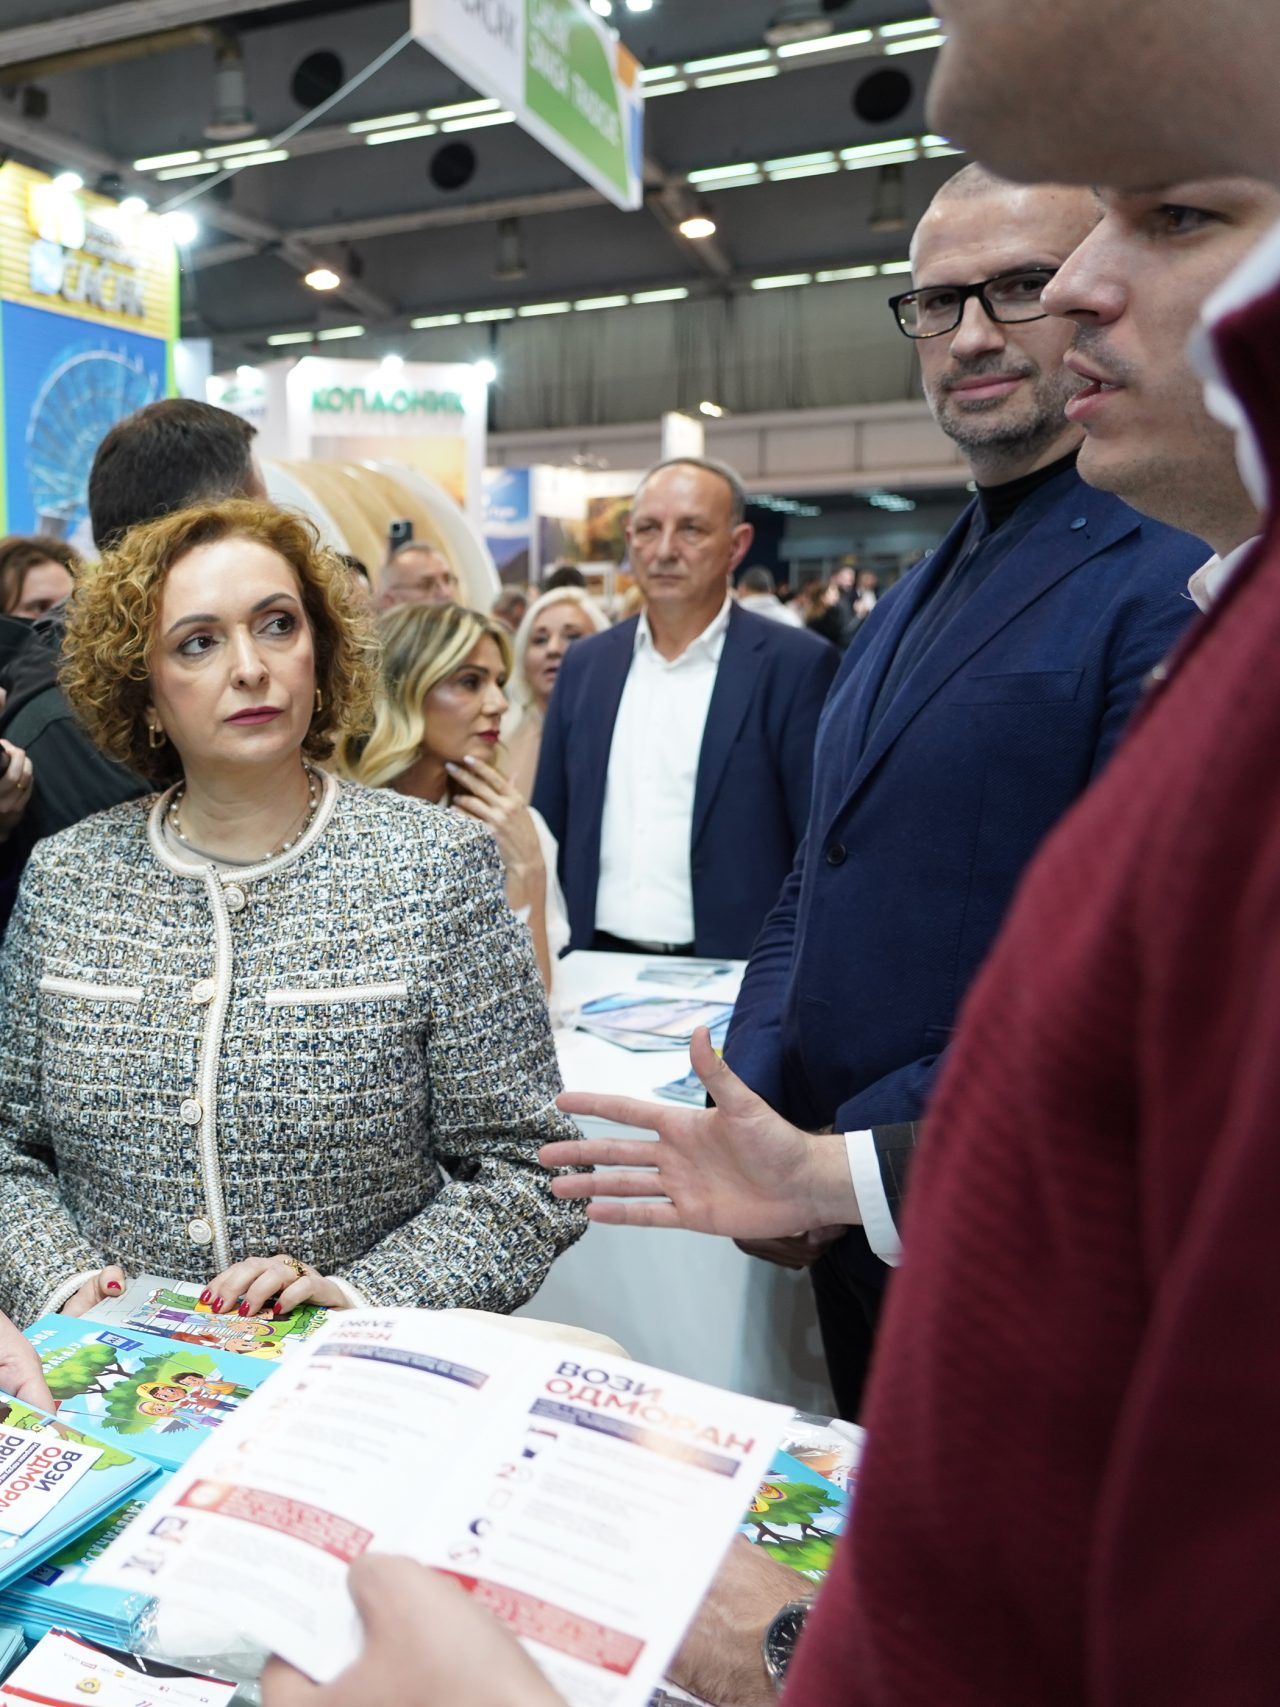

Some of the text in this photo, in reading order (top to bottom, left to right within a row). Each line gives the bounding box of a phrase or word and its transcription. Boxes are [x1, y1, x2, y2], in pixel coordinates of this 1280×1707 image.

[556, 1361, 663, 1402] ВОЗИ
[545, 1378, 756, 1454] ОДМОРАН
[34, 1450, 82, 1492] ВОЗИ
